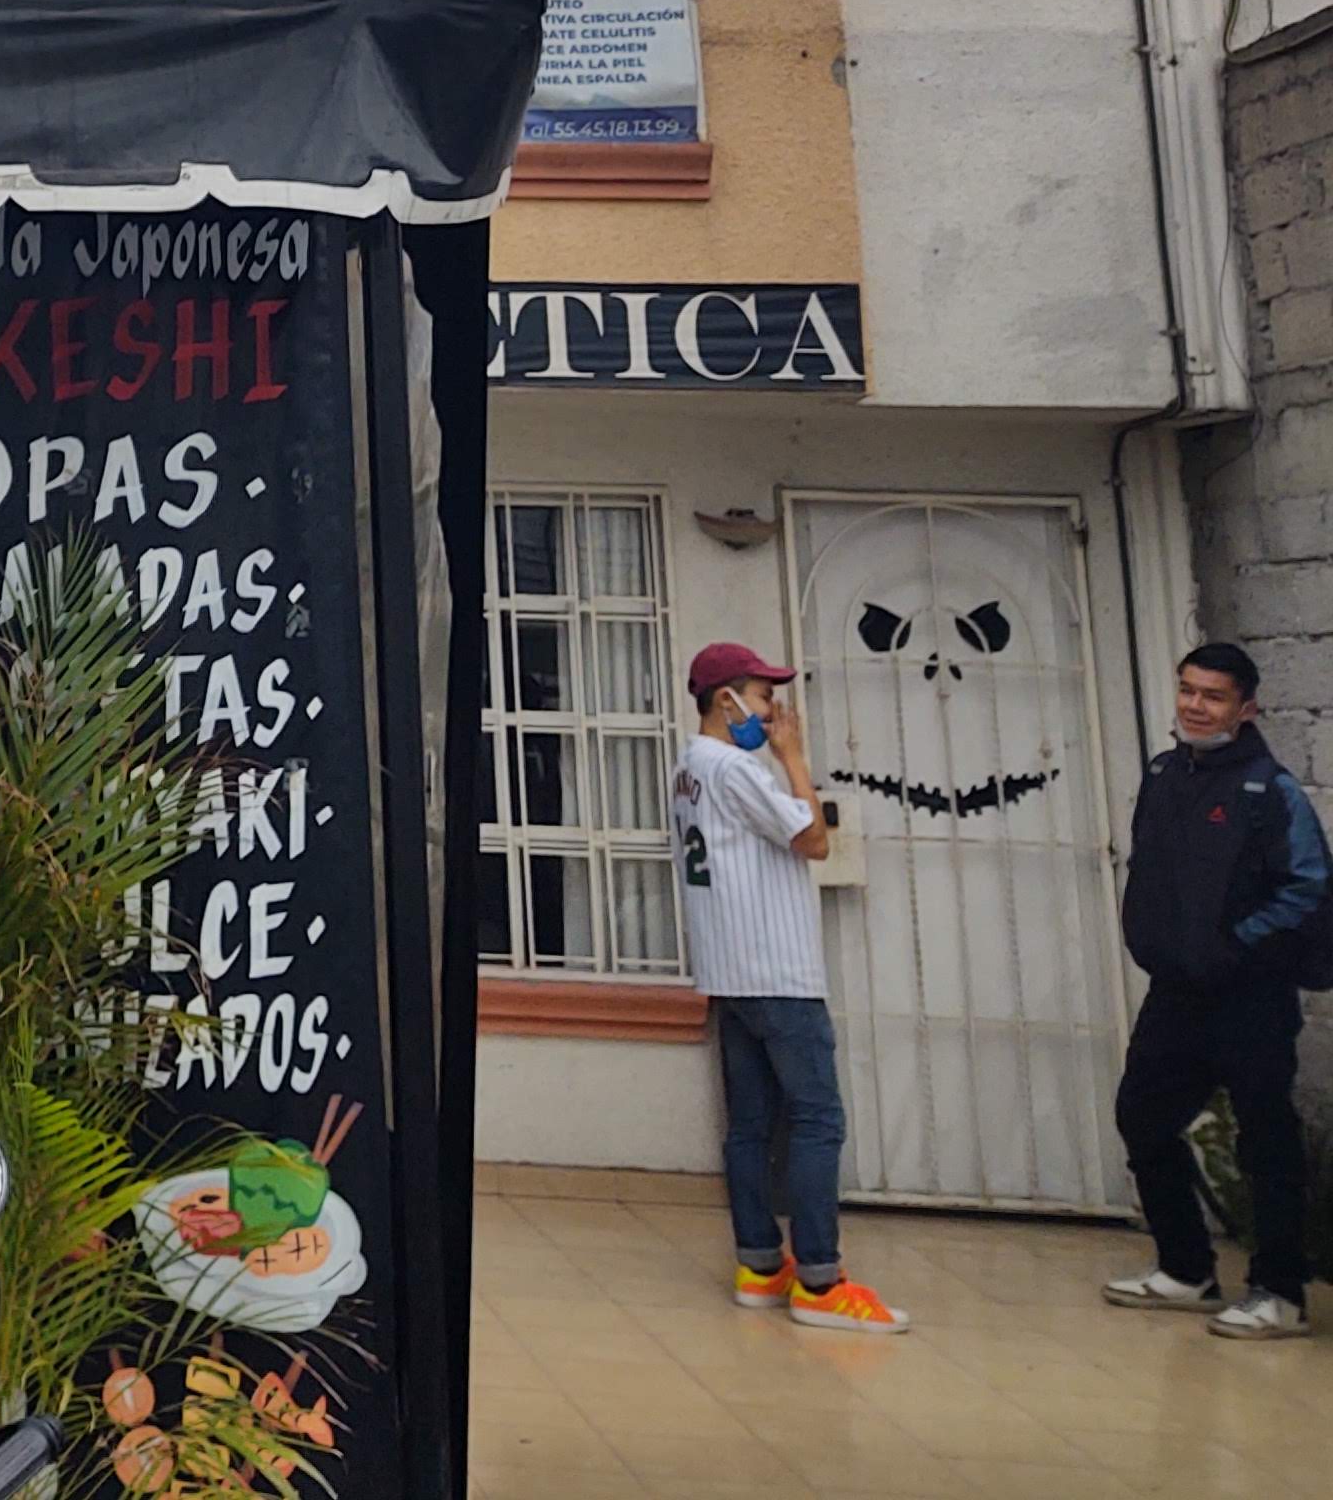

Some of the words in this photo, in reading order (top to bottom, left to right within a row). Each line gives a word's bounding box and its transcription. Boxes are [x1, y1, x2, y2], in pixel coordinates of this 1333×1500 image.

[580, 8, 685, 24] CIRCULACIÓN
[580, 26, 657, 39] CELULITIS
[569, 43, 648, 54] ABDOMEN
[588, 58, 607, 69] LA
[612, 57, 645, 69] PIEL
[577, 72, 647, 84] ESPALDA
[73, 213, 310, 298] Japonesa
